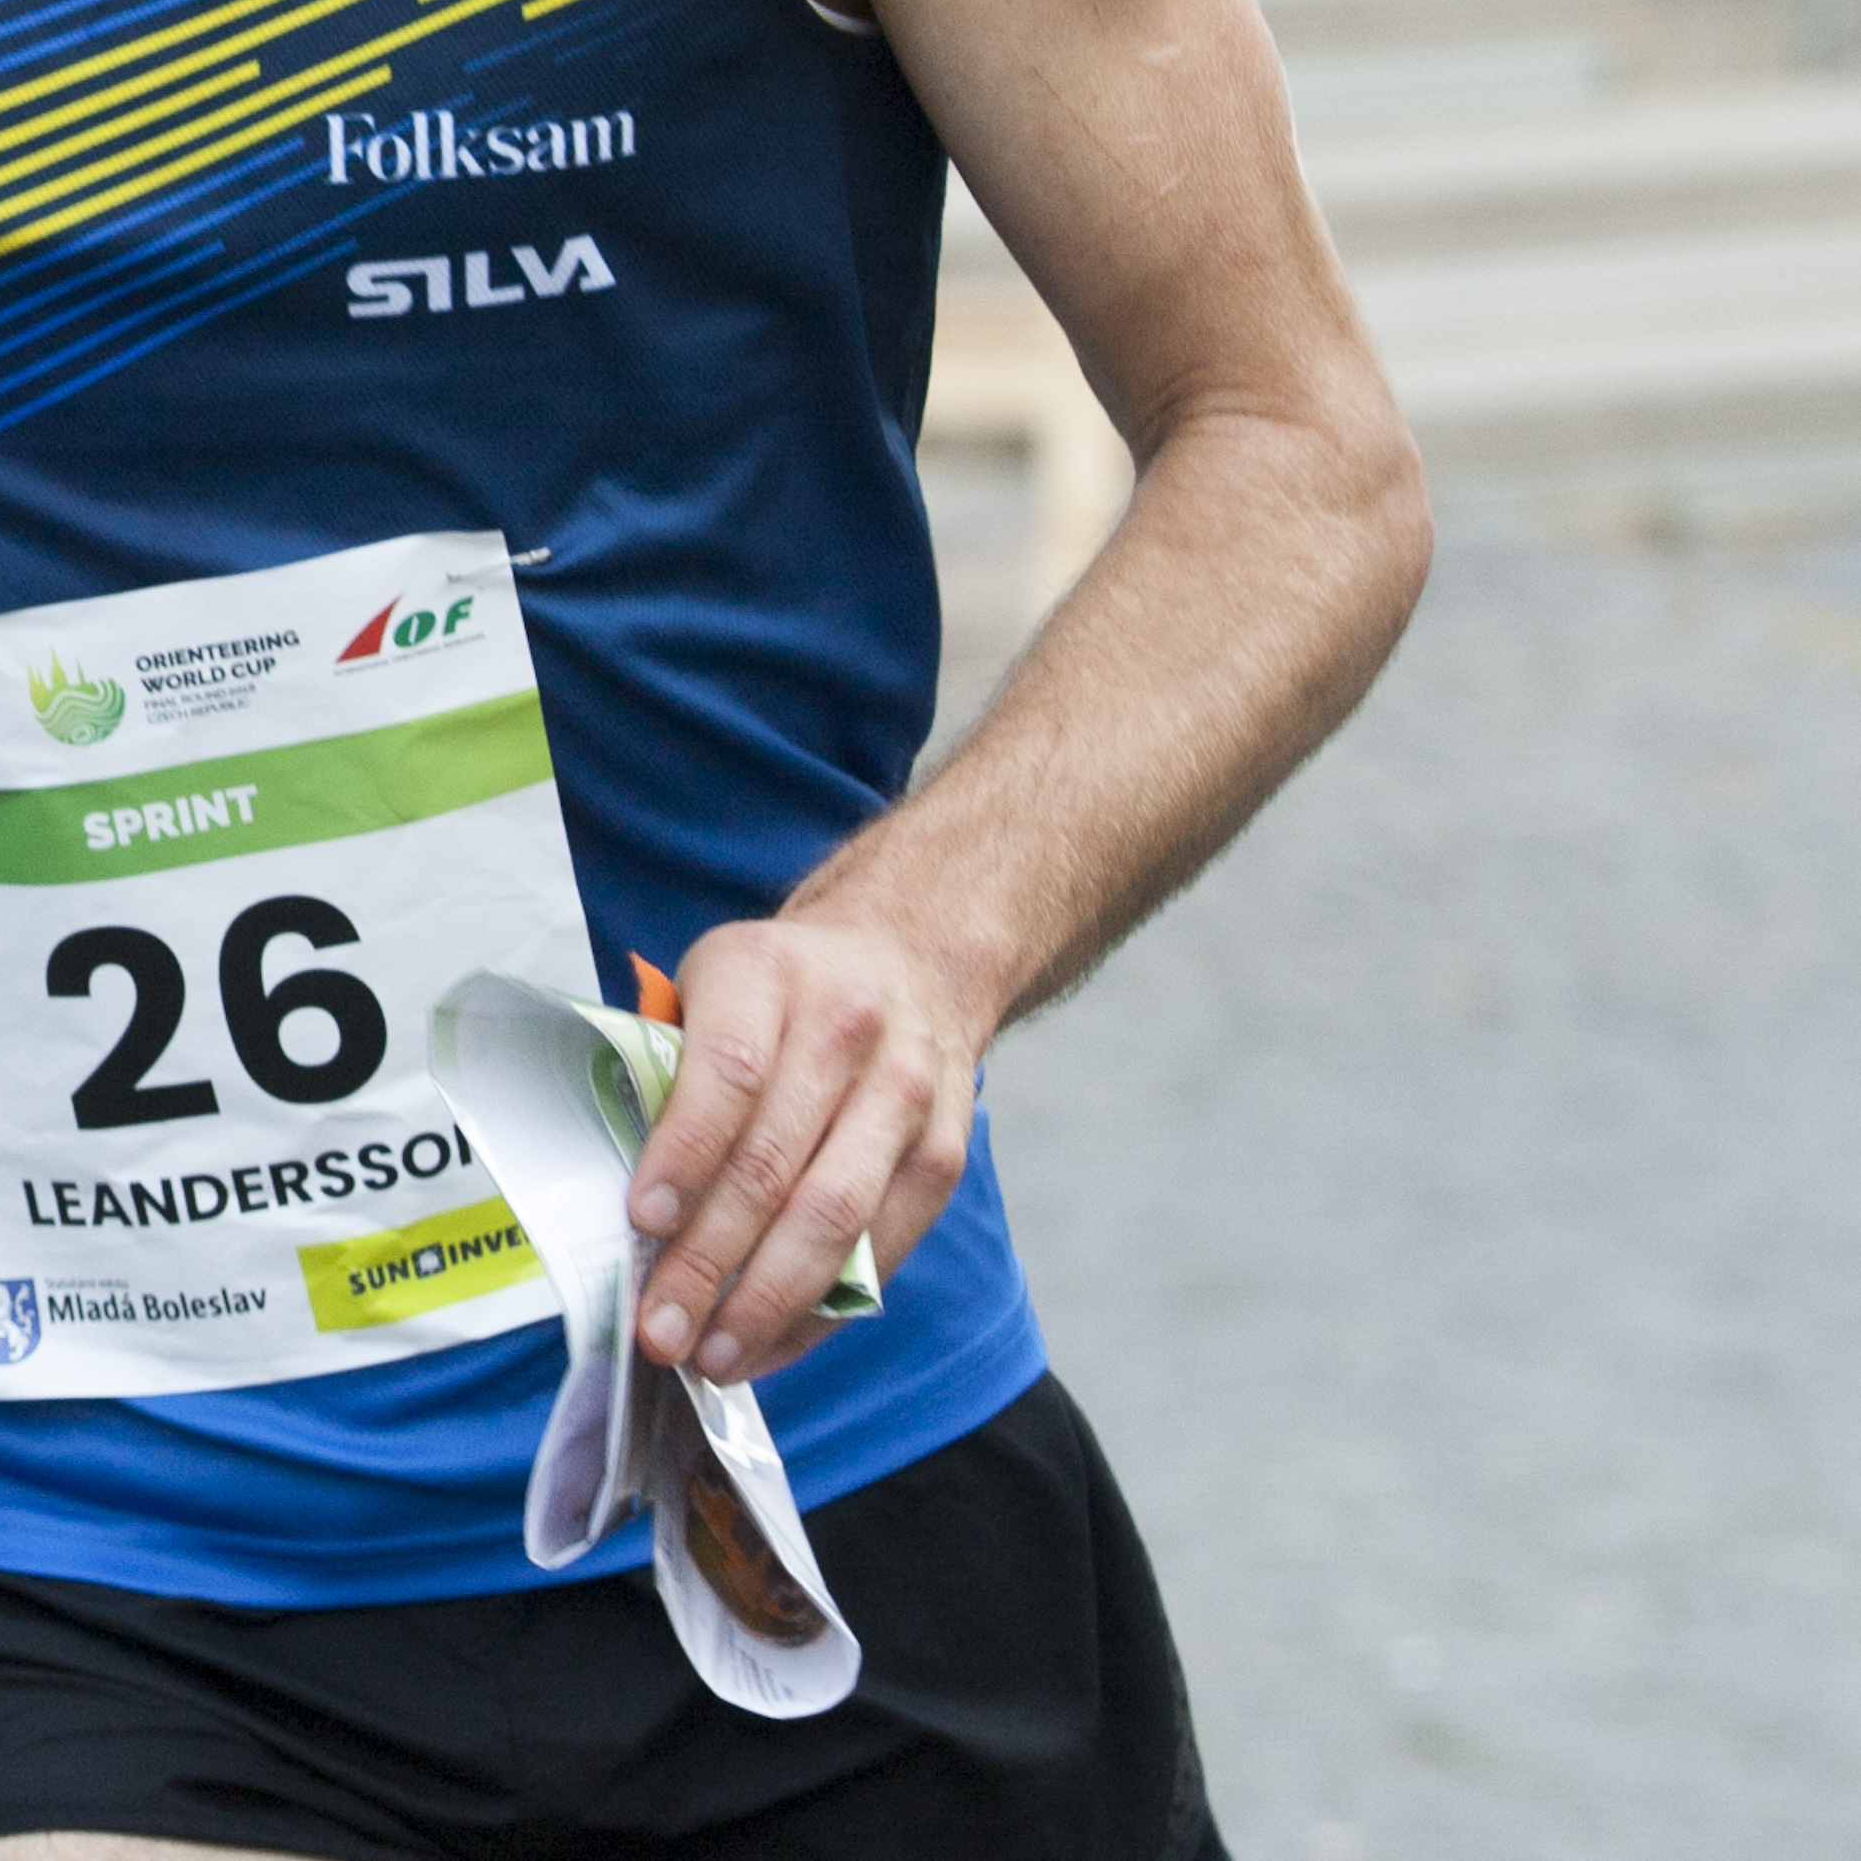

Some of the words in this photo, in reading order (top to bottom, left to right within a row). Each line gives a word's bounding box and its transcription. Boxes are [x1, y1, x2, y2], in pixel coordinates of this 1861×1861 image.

[325, 109, 636, 186] Folksam
[345, 233, 616, 319] SILVA
[135, 629, 301, 673] ORIENTEERING
[141, 665, 227, 694] WORLD
[230, 656, 276, 680] CUP
[83, 783, 259, 852] SPRINT
[45, 894, 388, 1130] 26
[46, 1292, 137, 1324] Mladá
[142, 1286, 267, 1322] Boleslav
